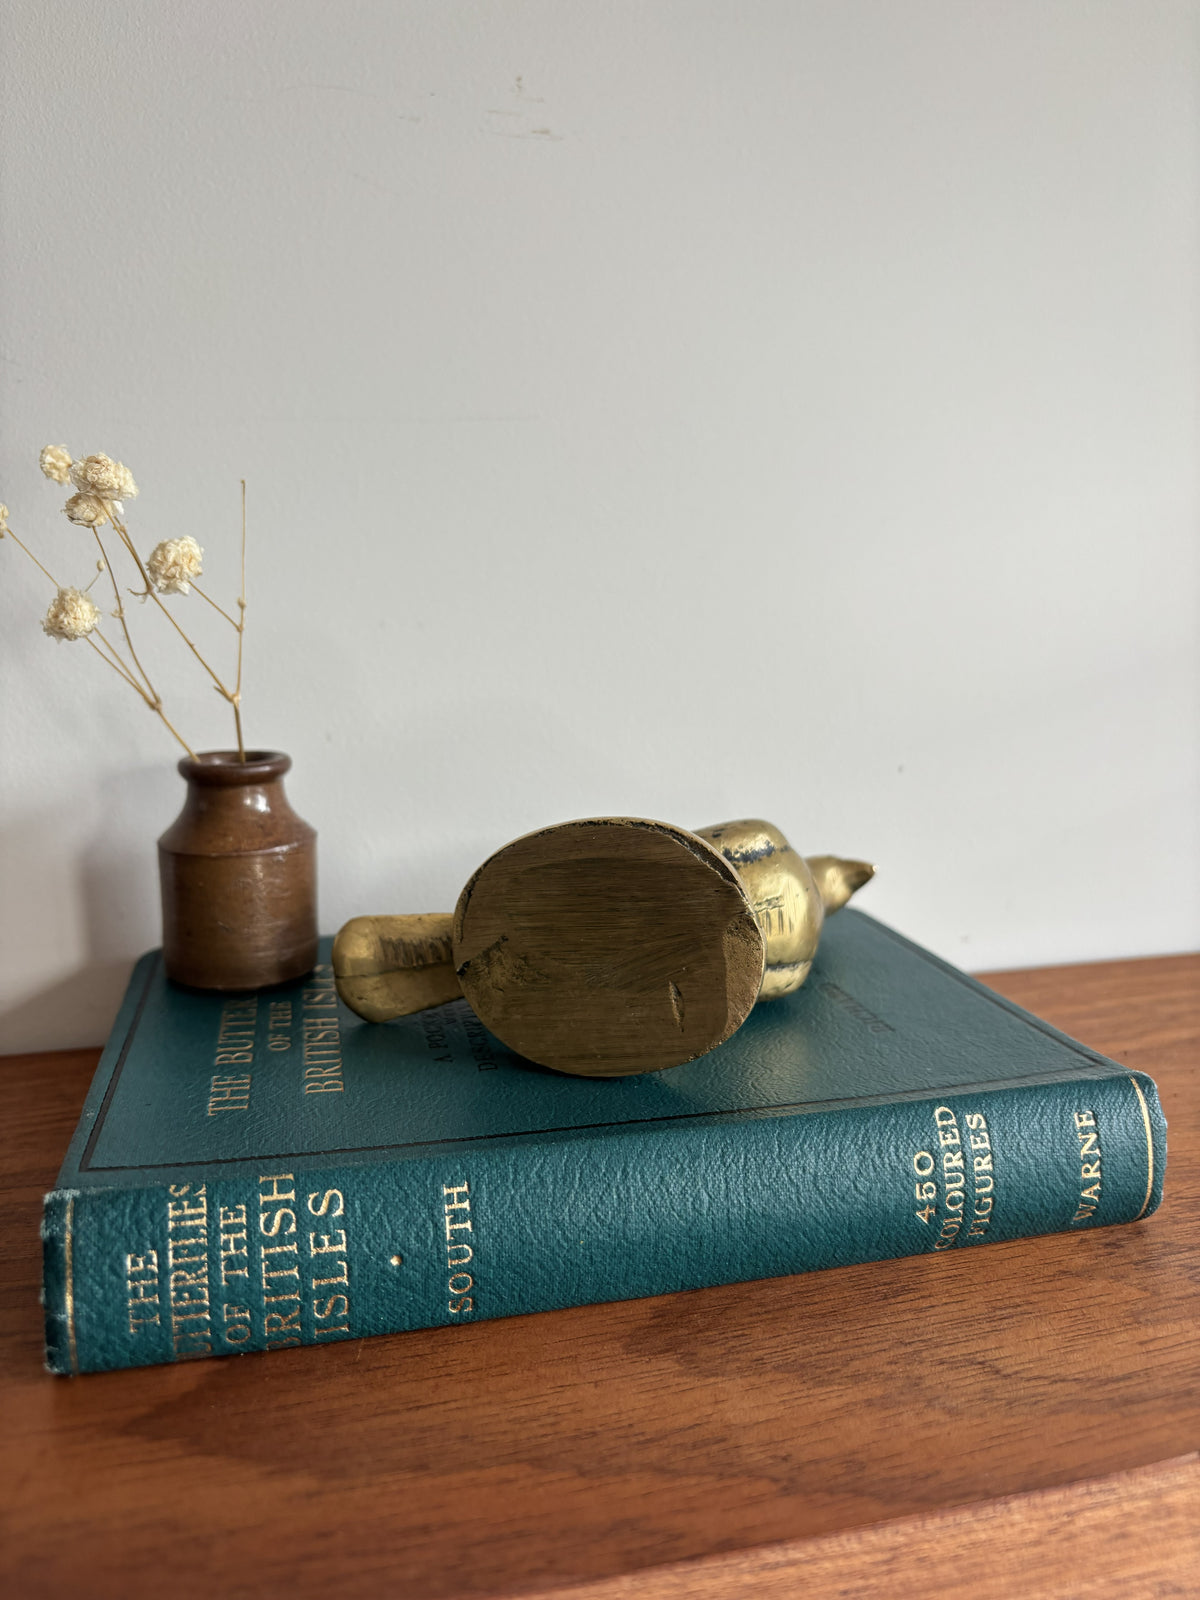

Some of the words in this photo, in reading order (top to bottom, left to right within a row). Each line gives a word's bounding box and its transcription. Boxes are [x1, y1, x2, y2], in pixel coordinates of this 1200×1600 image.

[214, 993, 258, 1066] BUTTER
[268, 1032, 292, 1051] OF
[269, 1001, 292, 1028] THE
[208, 1074, 251, 1116] THE
[303, 1017, 344, 1095] BRITISH
[433, 1053, 453, 1063] A
[913, 1150, 937, 1225] 450
[934, 1105, 966, 1250] COLOURED
[965, 1112, 995, 1238] FIGURES
[1072, 1109, 1102, 1224] WARNE
[168, 1183, 213, 1358] UTTERFLIES
[220, 1203, 249, 1287] THE
[307, 1187, 350, 1339] ISLES
[443, 1180, 474, 1313] SOUTH
[126, 1249, 160, 1334] THE
[222, 1302, 251, 1345] OF
